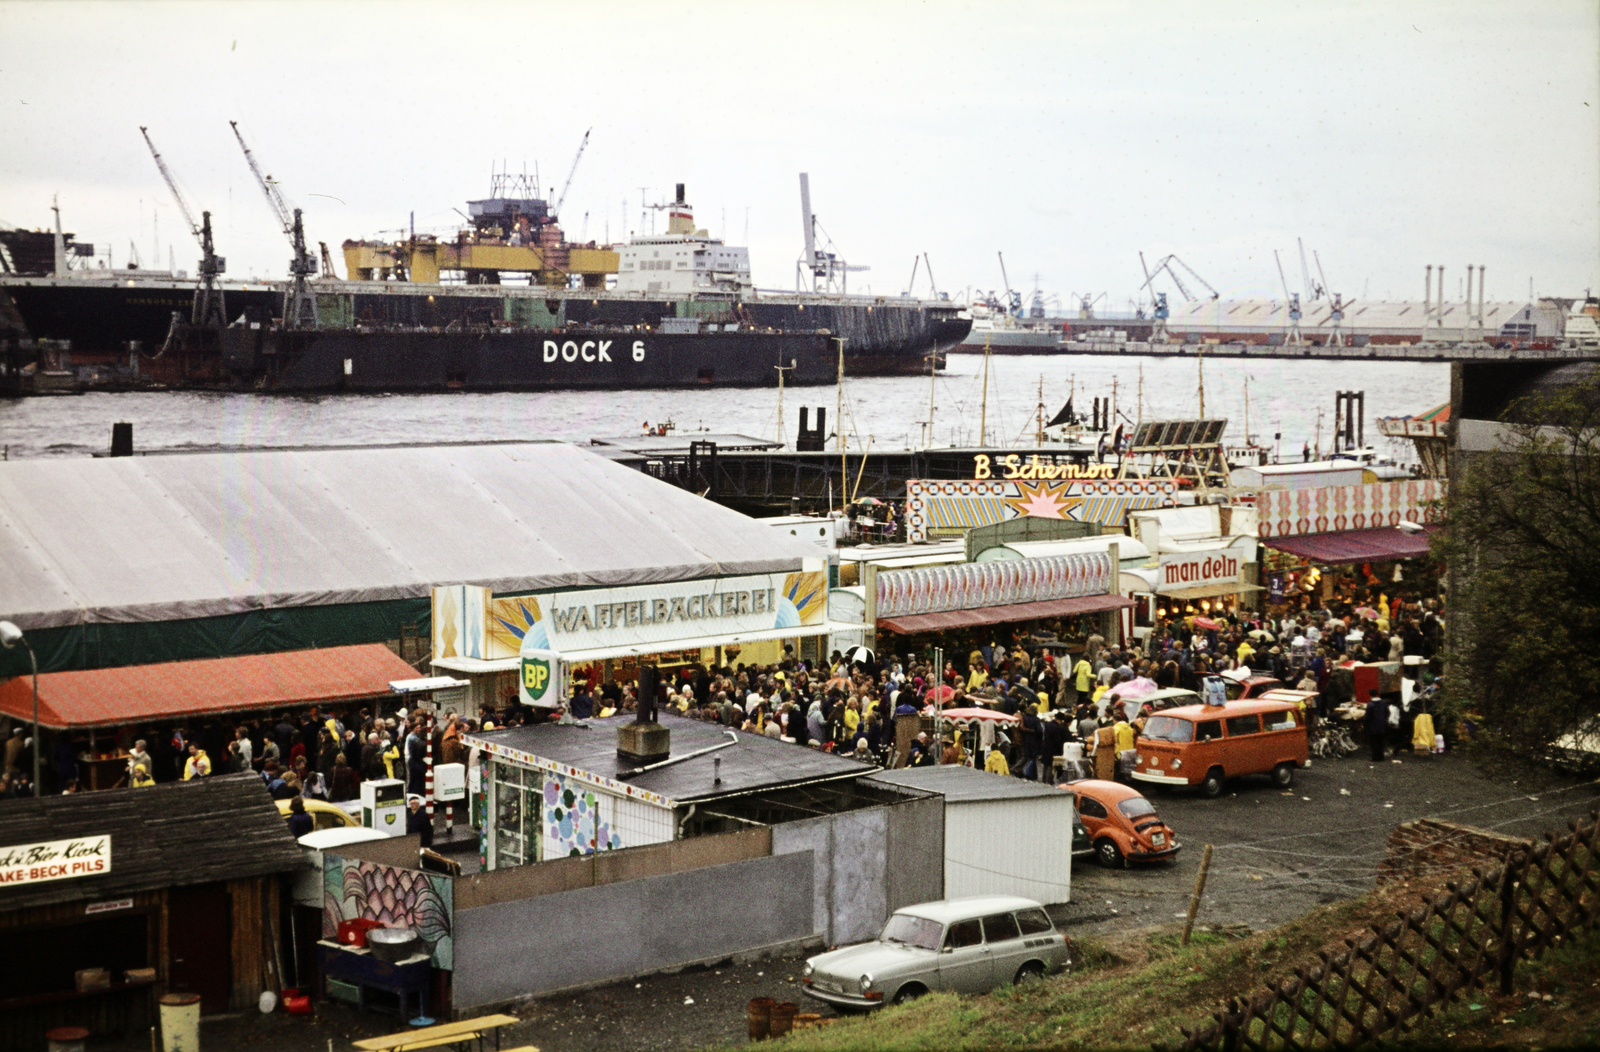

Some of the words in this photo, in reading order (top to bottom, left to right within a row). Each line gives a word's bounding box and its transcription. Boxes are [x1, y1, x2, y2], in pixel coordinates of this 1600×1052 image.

[543, 340, 612, 362] DOCK
[632, 340, 645, 362] 6
[974, 454, 996, 479] B.
[551, 588, 776, 634] WAFFELBÄCKEREI
[524, 663, 548, 690] BP
[26, 846, 59, 866] Bier
[61, 839, 107, 859] Kiosk
[72, 859, 104, 874] PILS
